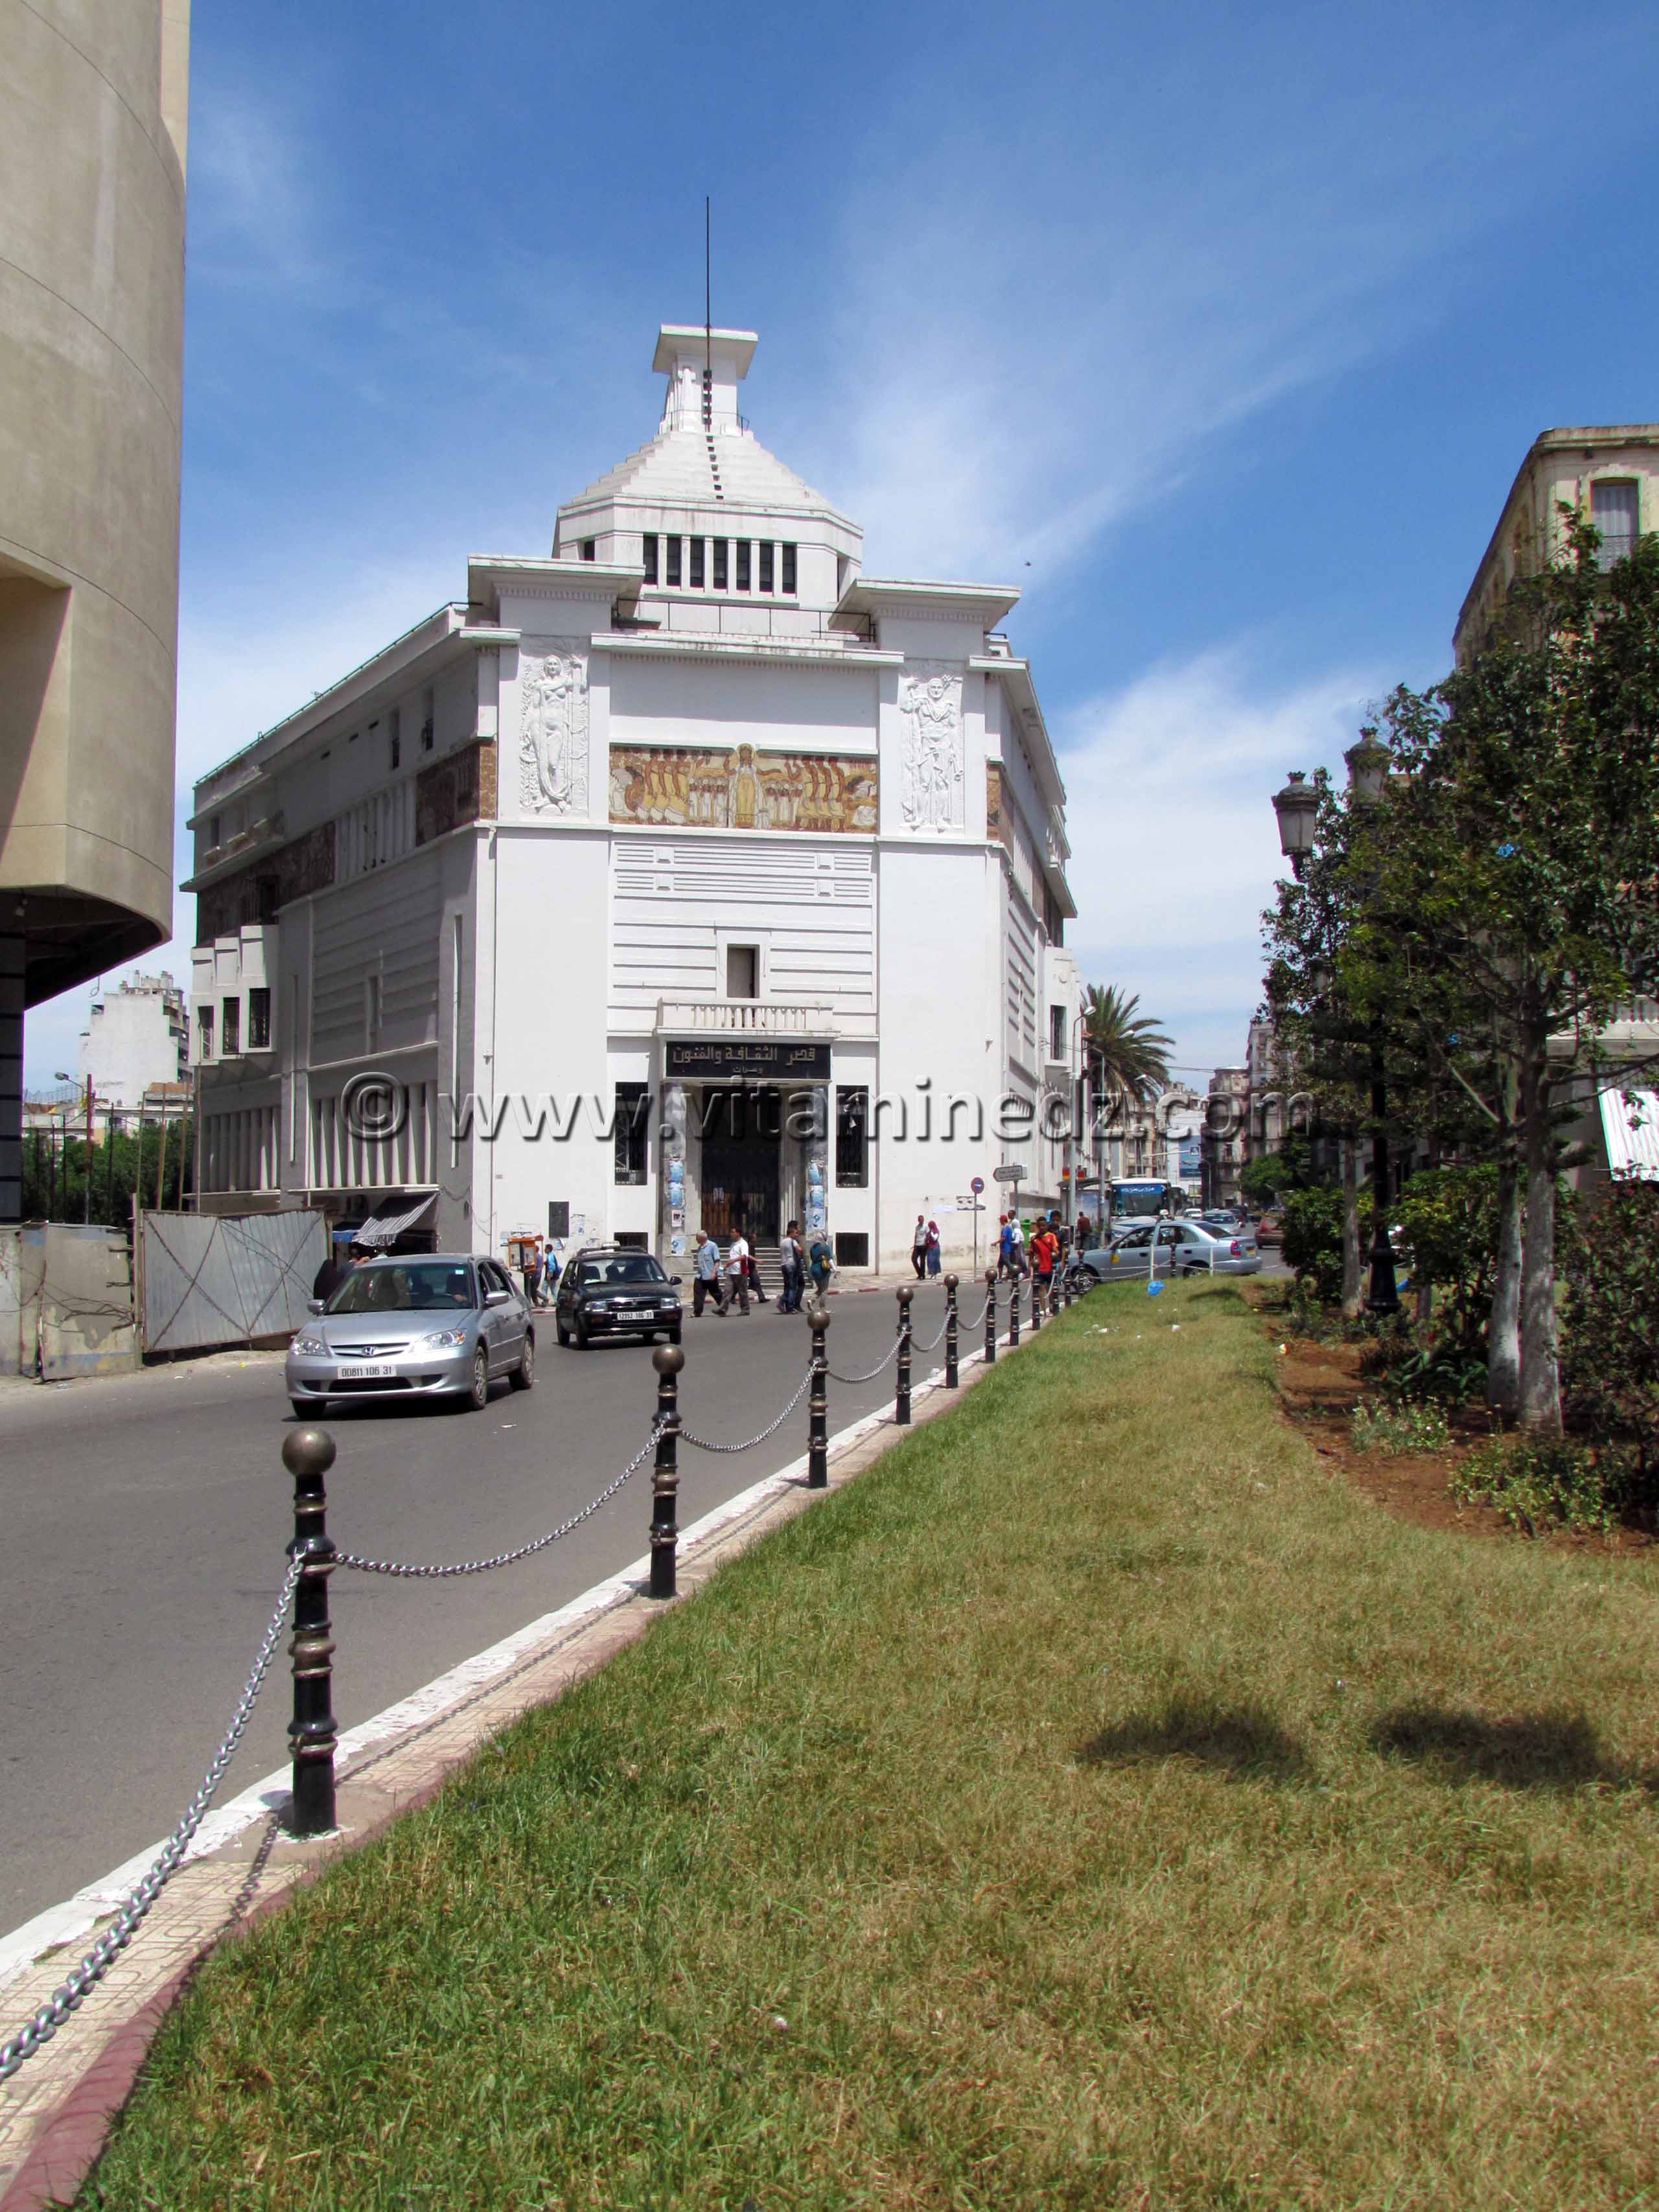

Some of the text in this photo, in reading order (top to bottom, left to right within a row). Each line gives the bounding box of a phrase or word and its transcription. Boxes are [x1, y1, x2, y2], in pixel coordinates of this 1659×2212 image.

[672, 1045, 816, 1066] قصر الثقافة والفنون
[342, 1365, 392, 1377] 00811 106 31
